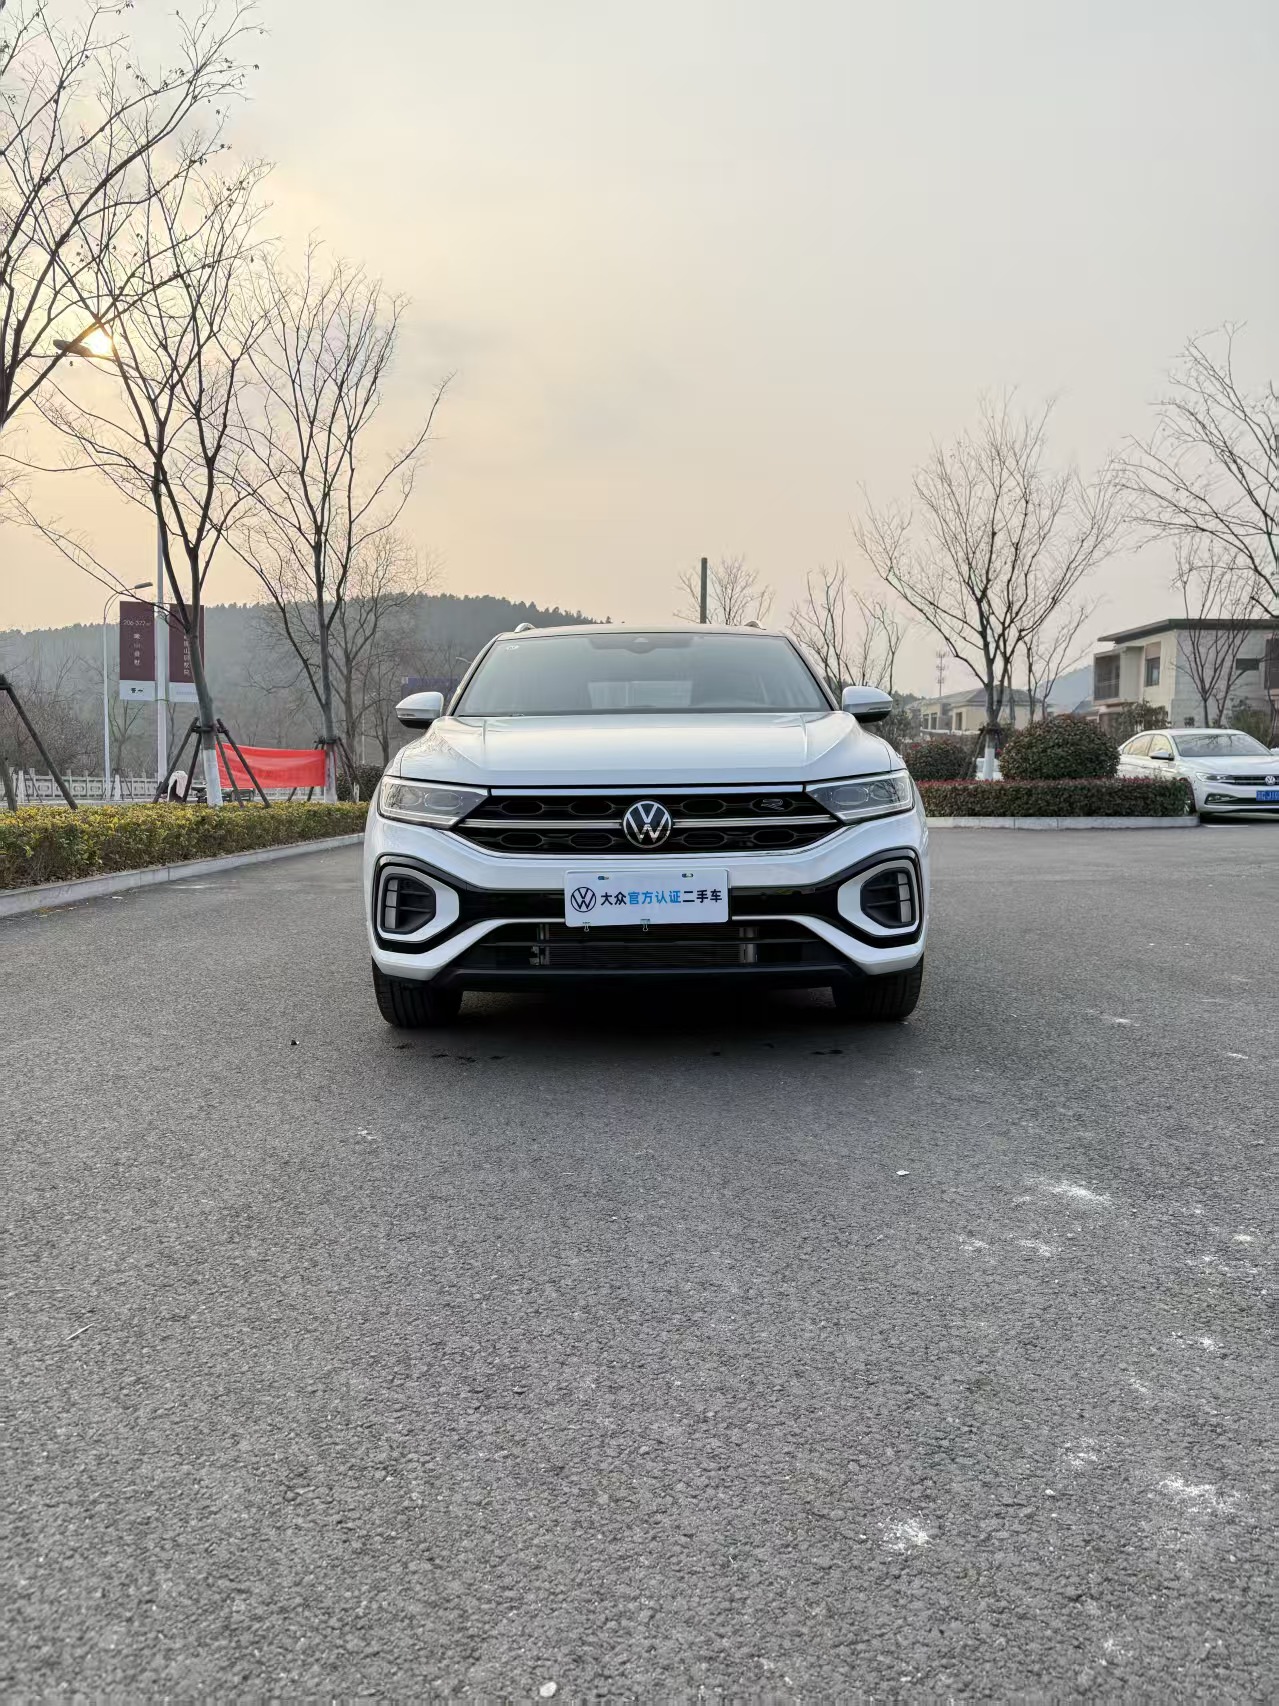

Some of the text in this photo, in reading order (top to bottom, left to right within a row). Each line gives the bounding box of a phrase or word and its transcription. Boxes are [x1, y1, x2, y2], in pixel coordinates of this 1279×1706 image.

[600, 888, 723, 906] 大众官方认证二手车
